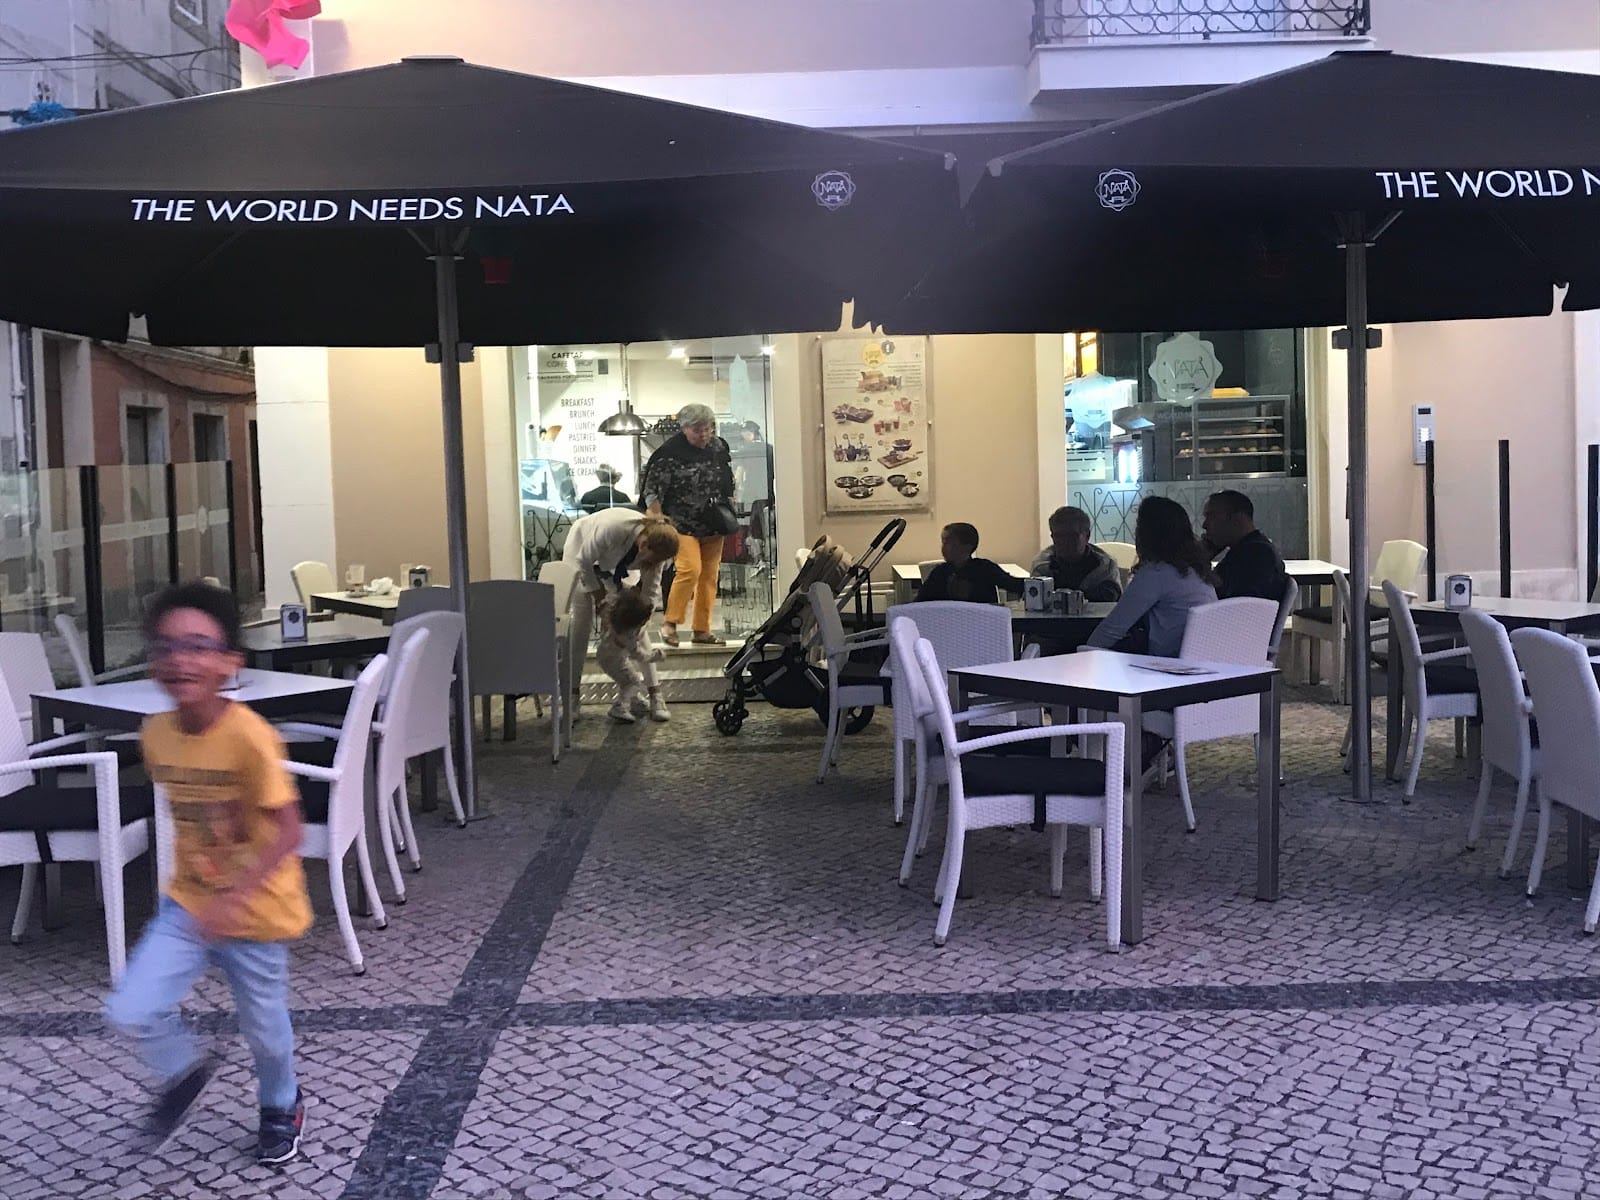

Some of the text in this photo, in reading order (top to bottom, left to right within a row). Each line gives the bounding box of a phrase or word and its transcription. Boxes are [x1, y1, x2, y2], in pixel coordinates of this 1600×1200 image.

[820, 180, 847, 196] NATA
[1375, 171, 1440, 198] THE
[1445, 169, 1574, 198] WORLD
[1103, 180, 1133, 198] NATA
[131, 193, 575, 222] THE WORLD NEEDS NATA
[560, 397, 594, 407] BREAKFAST
[569, 410, 595, 418] BRUNCH
[575, 421, 595, 430] LUNCH
[568, 433, 597, 441] PASTRIES
[573, 445, 597, 453] DINNER
[573, 456, 598, 465] SNACKS
